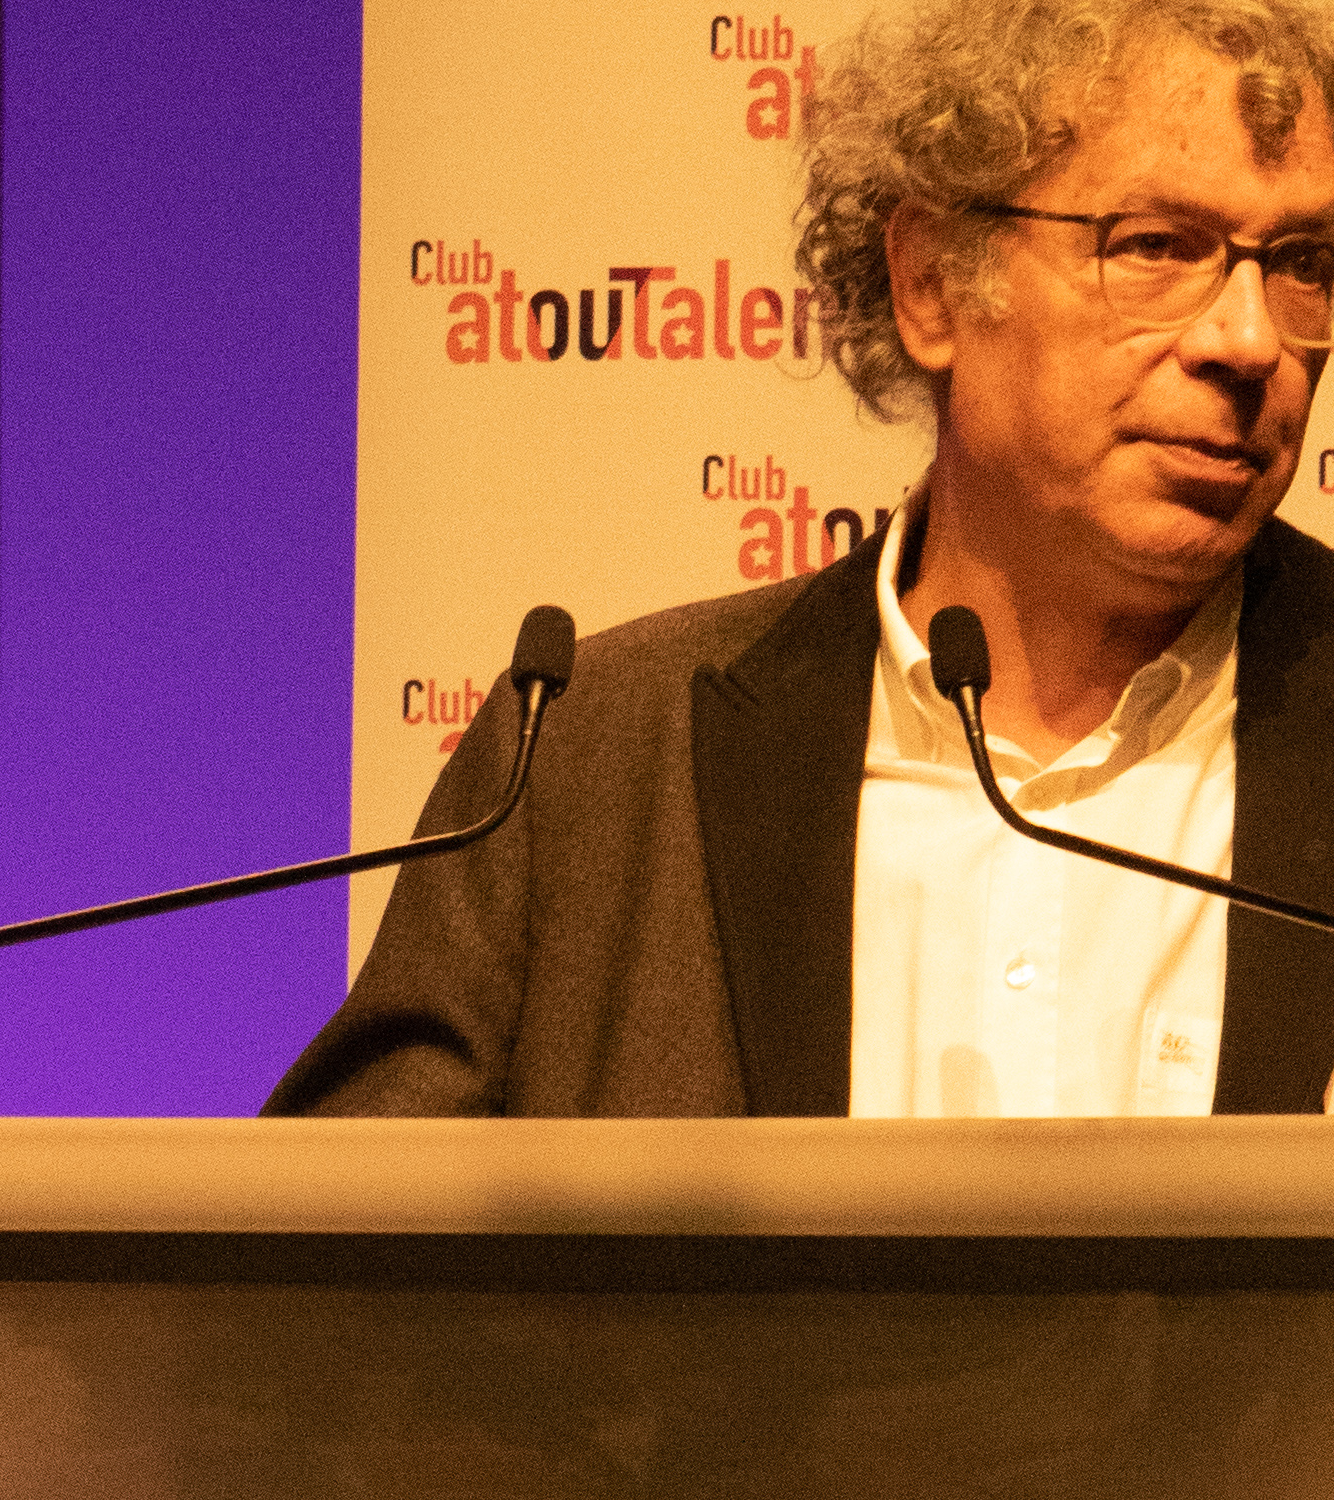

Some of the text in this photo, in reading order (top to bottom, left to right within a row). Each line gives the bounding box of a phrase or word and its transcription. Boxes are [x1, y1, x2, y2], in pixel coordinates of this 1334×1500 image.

[711, 15, 794, 60] Club
[411, 240, 493, 286] Club
[445, 259, 839, 364] atouTalen
[703, 455, 785, 500] Club
